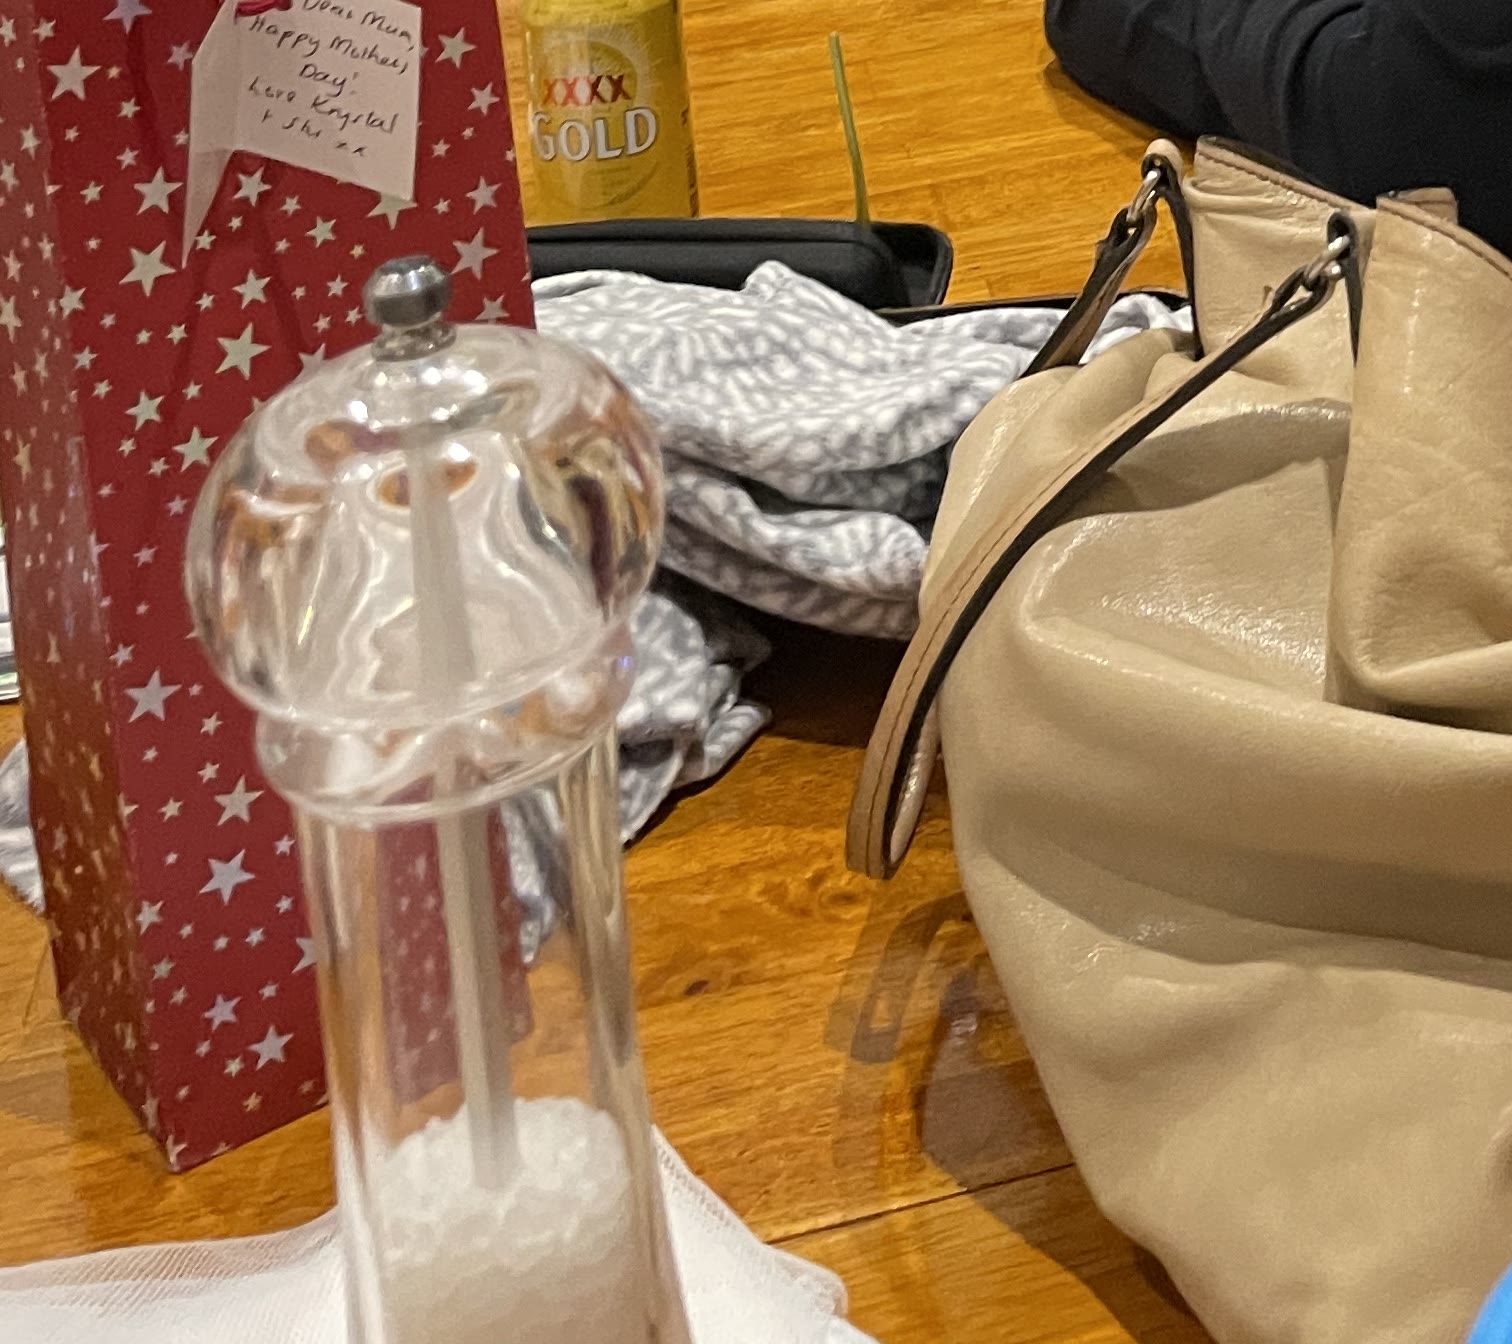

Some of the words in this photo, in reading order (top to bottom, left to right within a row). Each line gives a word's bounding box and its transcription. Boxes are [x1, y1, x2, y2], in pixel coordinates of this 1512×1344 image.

[249, 15, 320, 58] Happy
[541, 74, 632, 107] XXXX
[531, 106, 658, 162] GOLD
